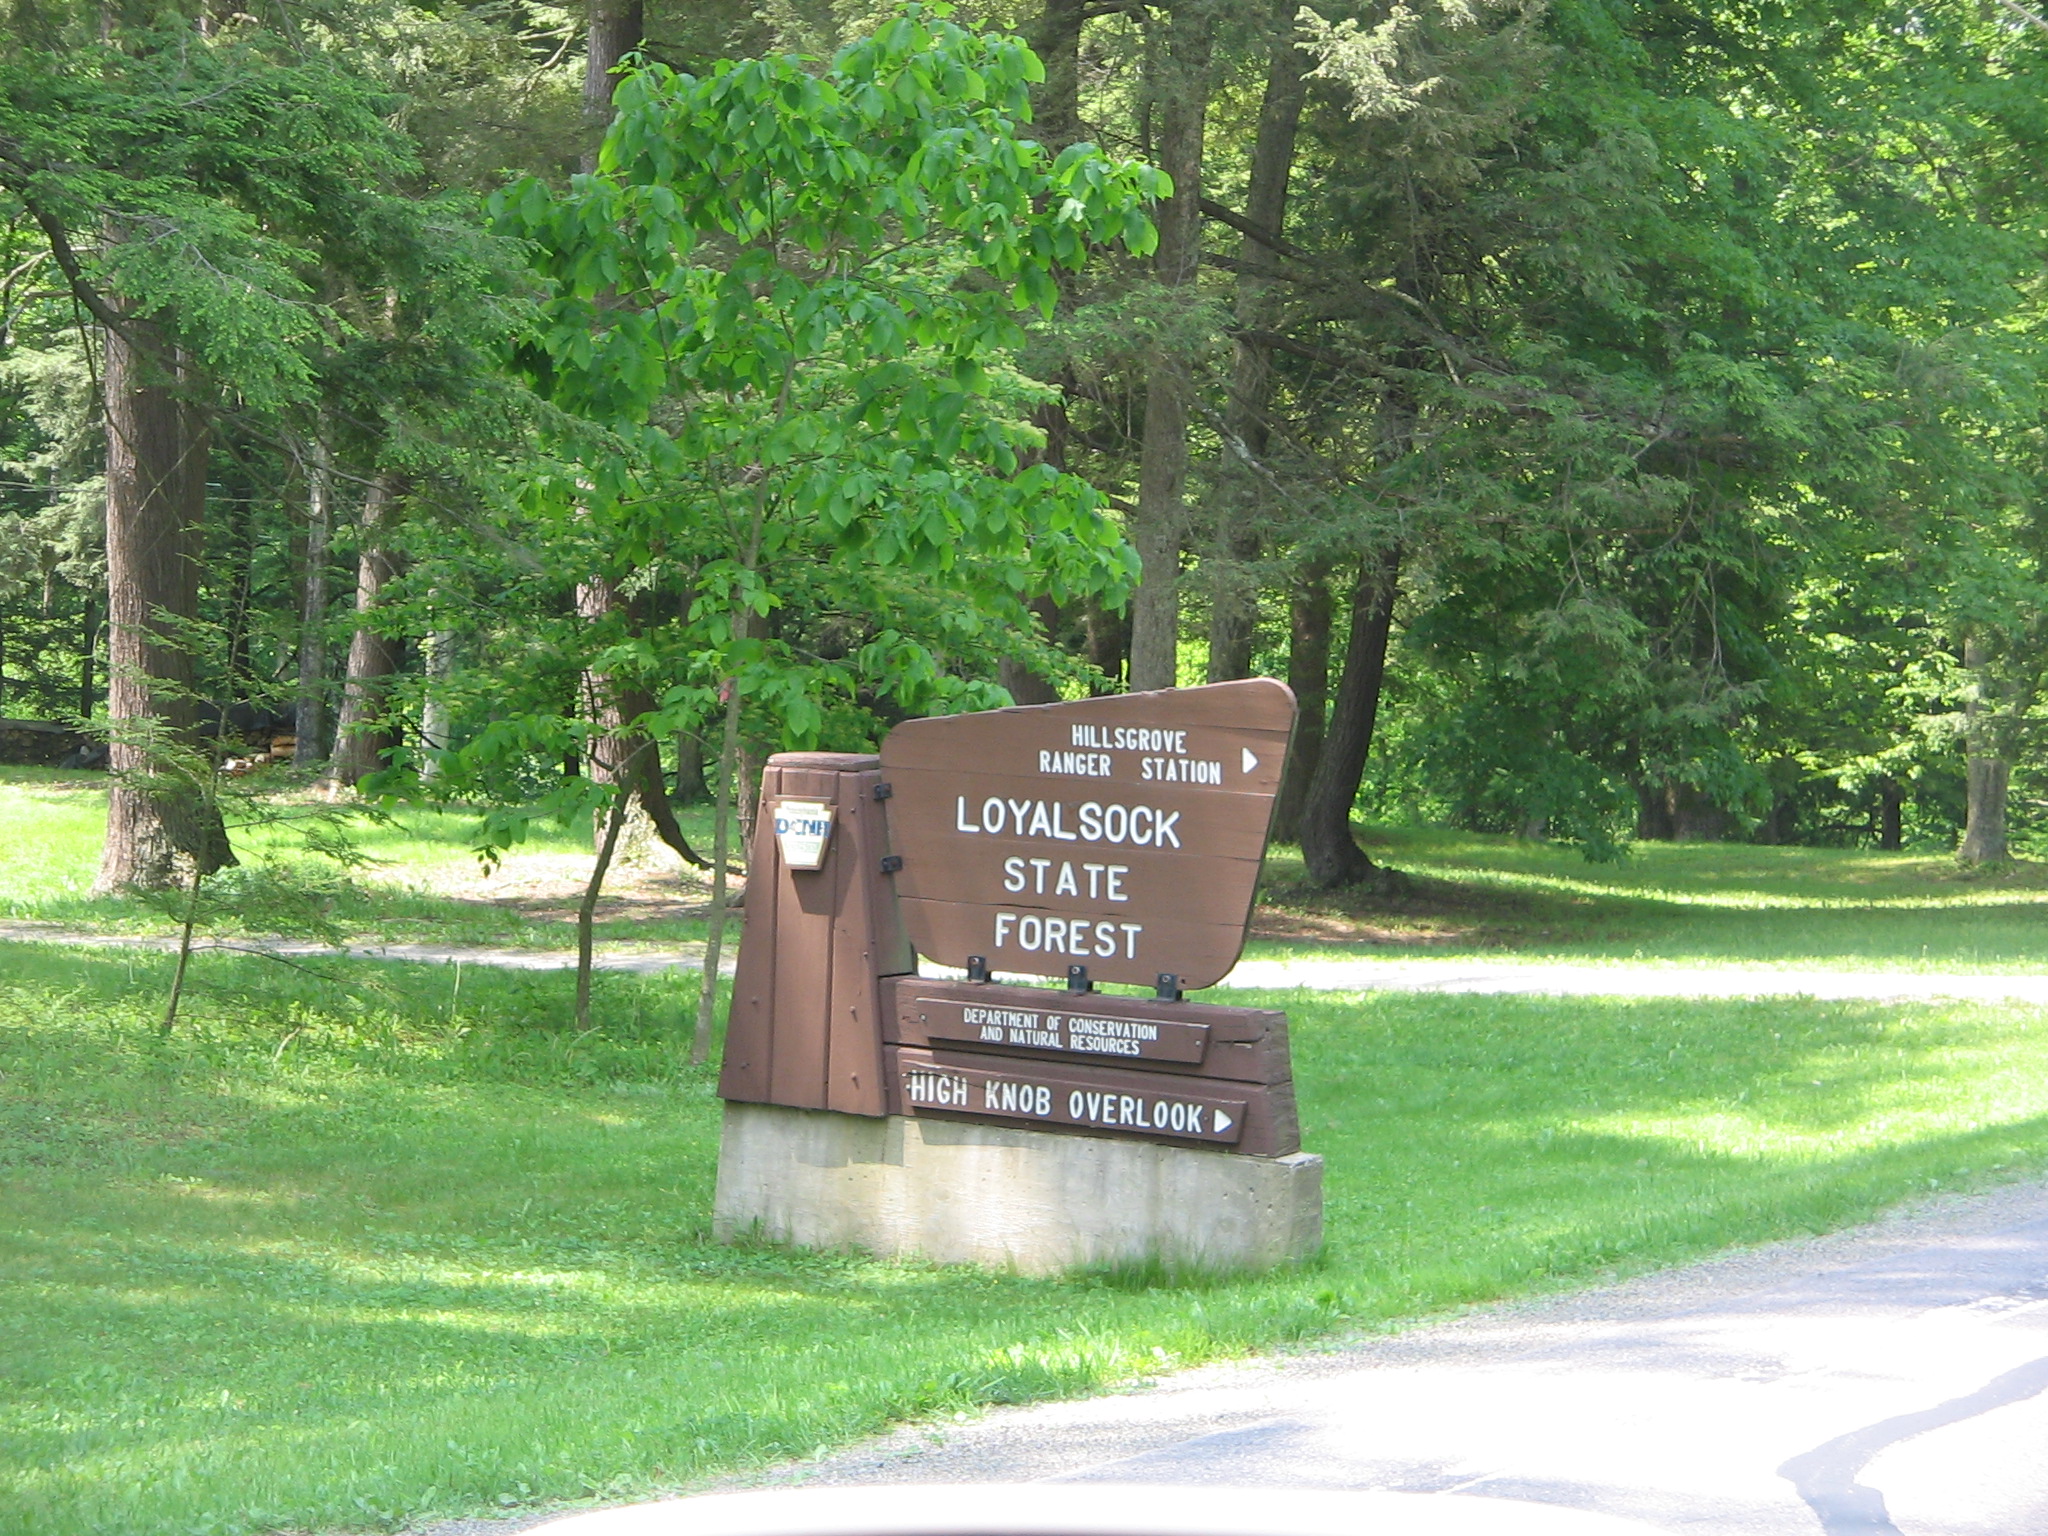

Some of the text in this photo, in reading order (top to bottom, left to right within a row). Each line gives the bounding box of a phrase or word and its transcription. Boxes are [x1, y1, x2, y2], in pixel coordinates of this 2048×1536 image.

[1071, 724, 1187, 754] HILLSGROVE
[1039, 750, 1222, 785] RANGER STATION
[956, 796, 1181, 849] LOYALSOCK
[1003, 857, 1130, 901] STATE
[995, 912, 1143, 959] FOREST
[964, 1008, 1158, 1041] DEPARTMENT OF CONSERVATION
[980, 1025, 1140, 1055] AND NATURAL RESOURCES
[910, 1070, 1203, 1134] HIGH KNOB OVERLOOK
